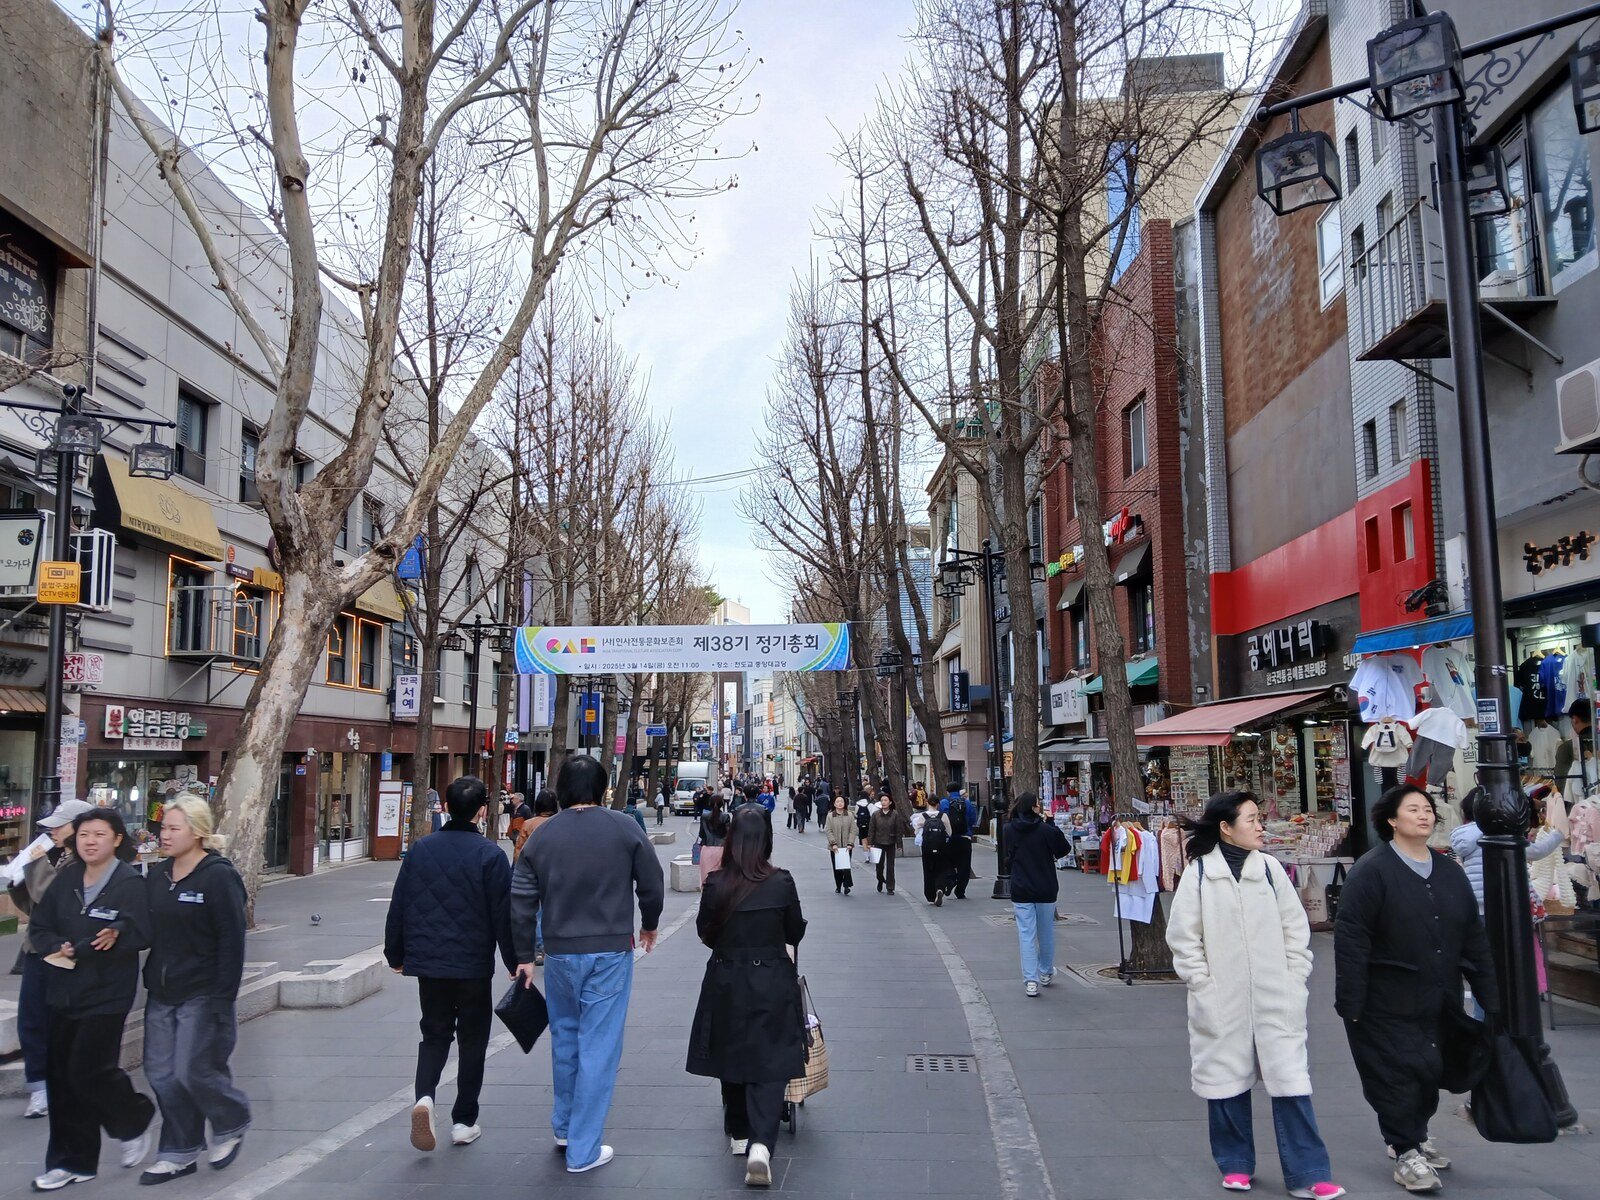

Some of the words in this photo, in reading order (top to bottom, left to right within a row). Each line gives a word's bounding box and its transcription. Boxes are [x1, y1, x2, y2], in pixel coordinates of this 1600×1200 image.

[128, 517, 162, 536] NIRVANA
[4, 558, 31, 570] 오가다
[40, 581, 77, 590] 불법주정차
[693, 635, 749, 652] 제38기
[755, 633, 819, 654] 정기총회
[1247, 618, 1314, 672] 공예나라
[755, 660, 787, 668] 중앙대교당
[400, 676, 418, 686] 만곡
[402, 687, 414, 709] 서예
